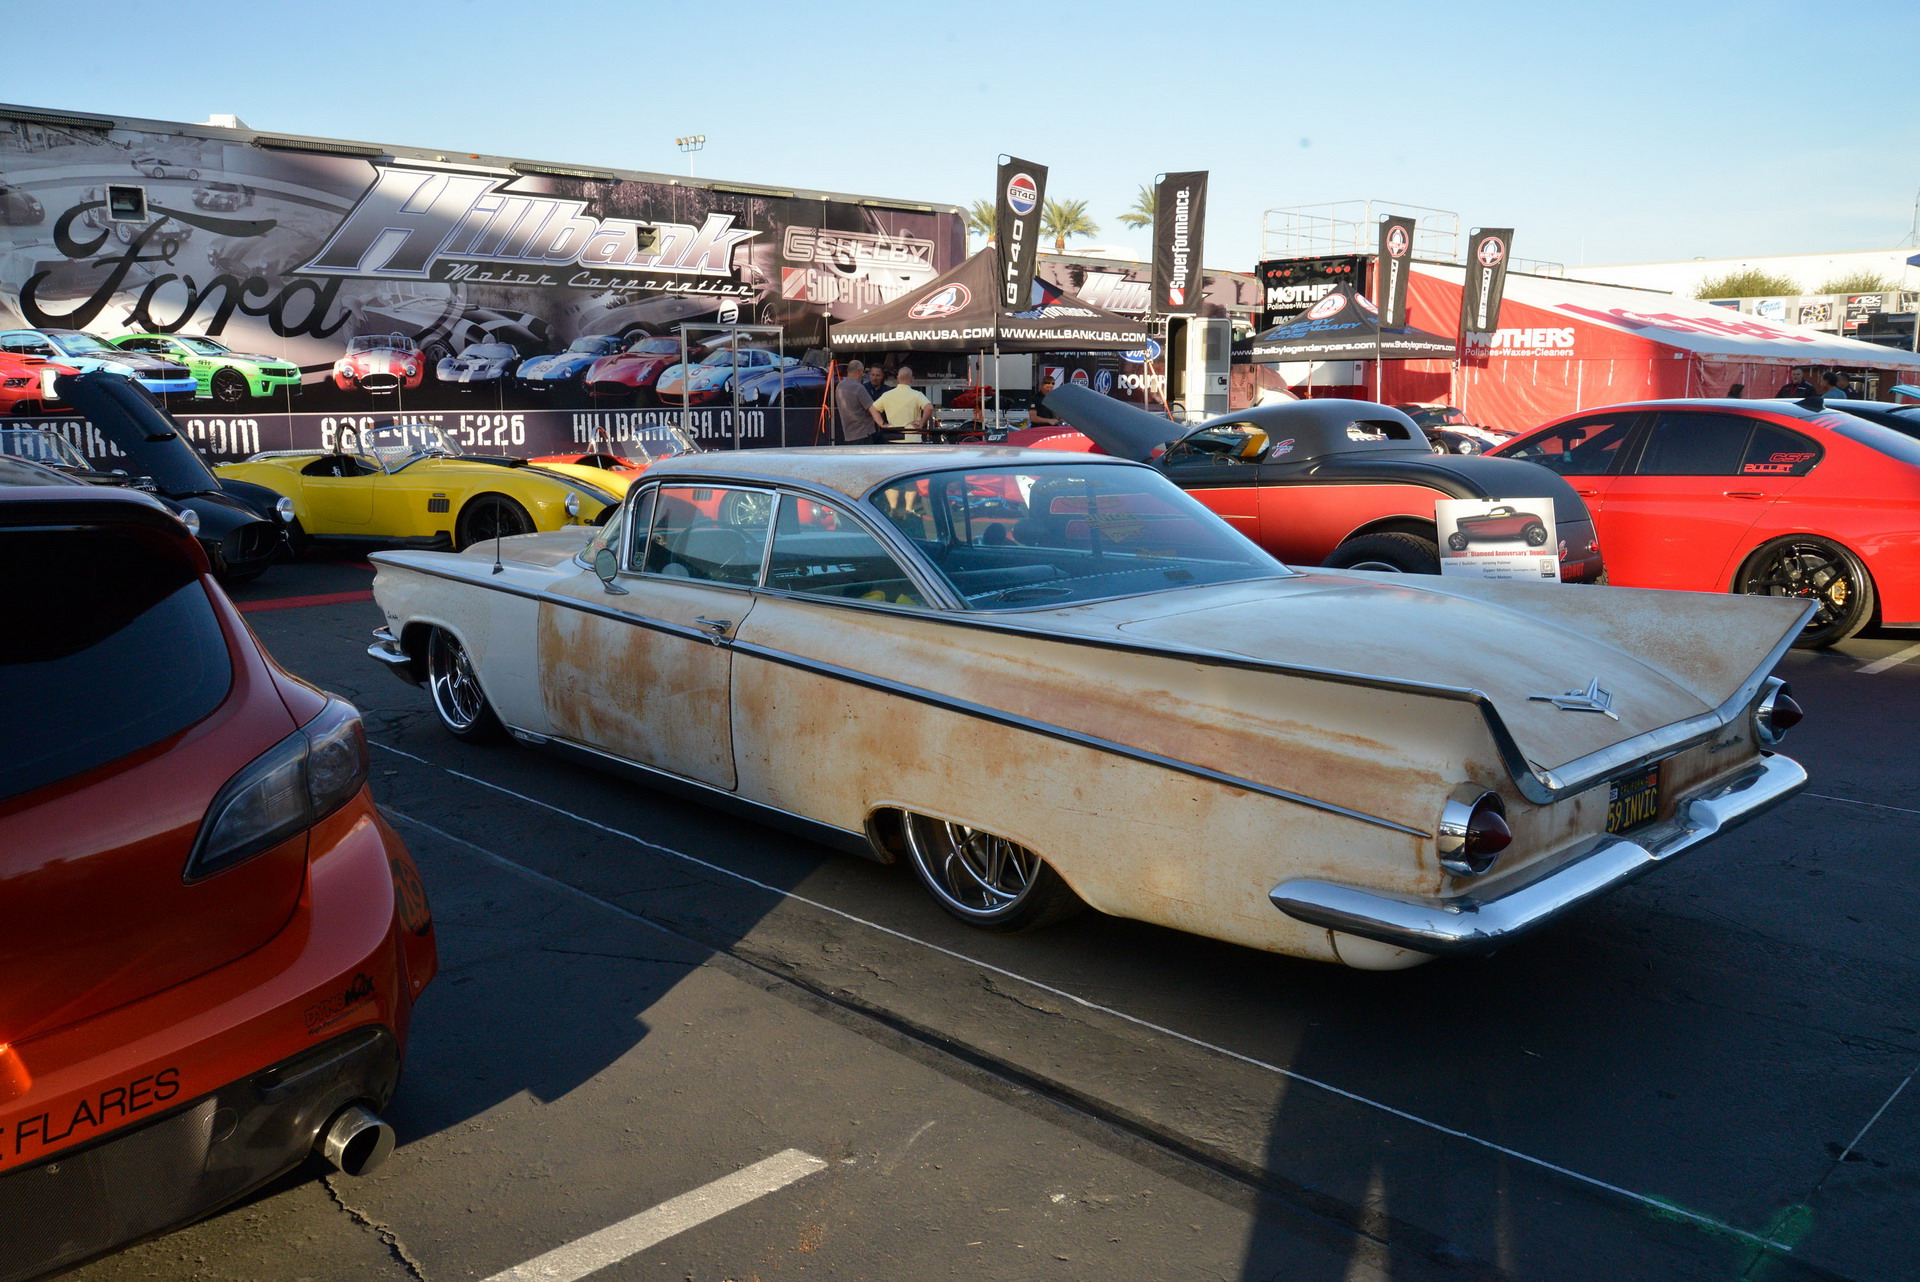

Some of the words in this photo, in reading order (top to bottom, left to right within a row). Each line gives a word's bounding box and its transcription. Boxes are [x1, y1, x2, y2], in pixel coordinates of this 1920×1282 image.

[1010, 188, 1035, 201] GT40
[297, 168, 763, 279] Hillbank
[1169, 186, 1190, 289] Superformance
[816, 236, 928, 263] SHELBY
[1007, 219, 1024, 304] GT40
[20, 200, 351, 340] Ford
[445, 263, 558, 286] Motor
[568, 271, 755, 296] Corporation
[831, 327, 994, 344] WWW.HILLBANKUSA.COM
[1000, 328, 1146, 342] WWW.HILLBANKUSA.COM
[1465, 327, 1575, 348] MOTHERS
[16, 1067, 180, 1154] FLARES
